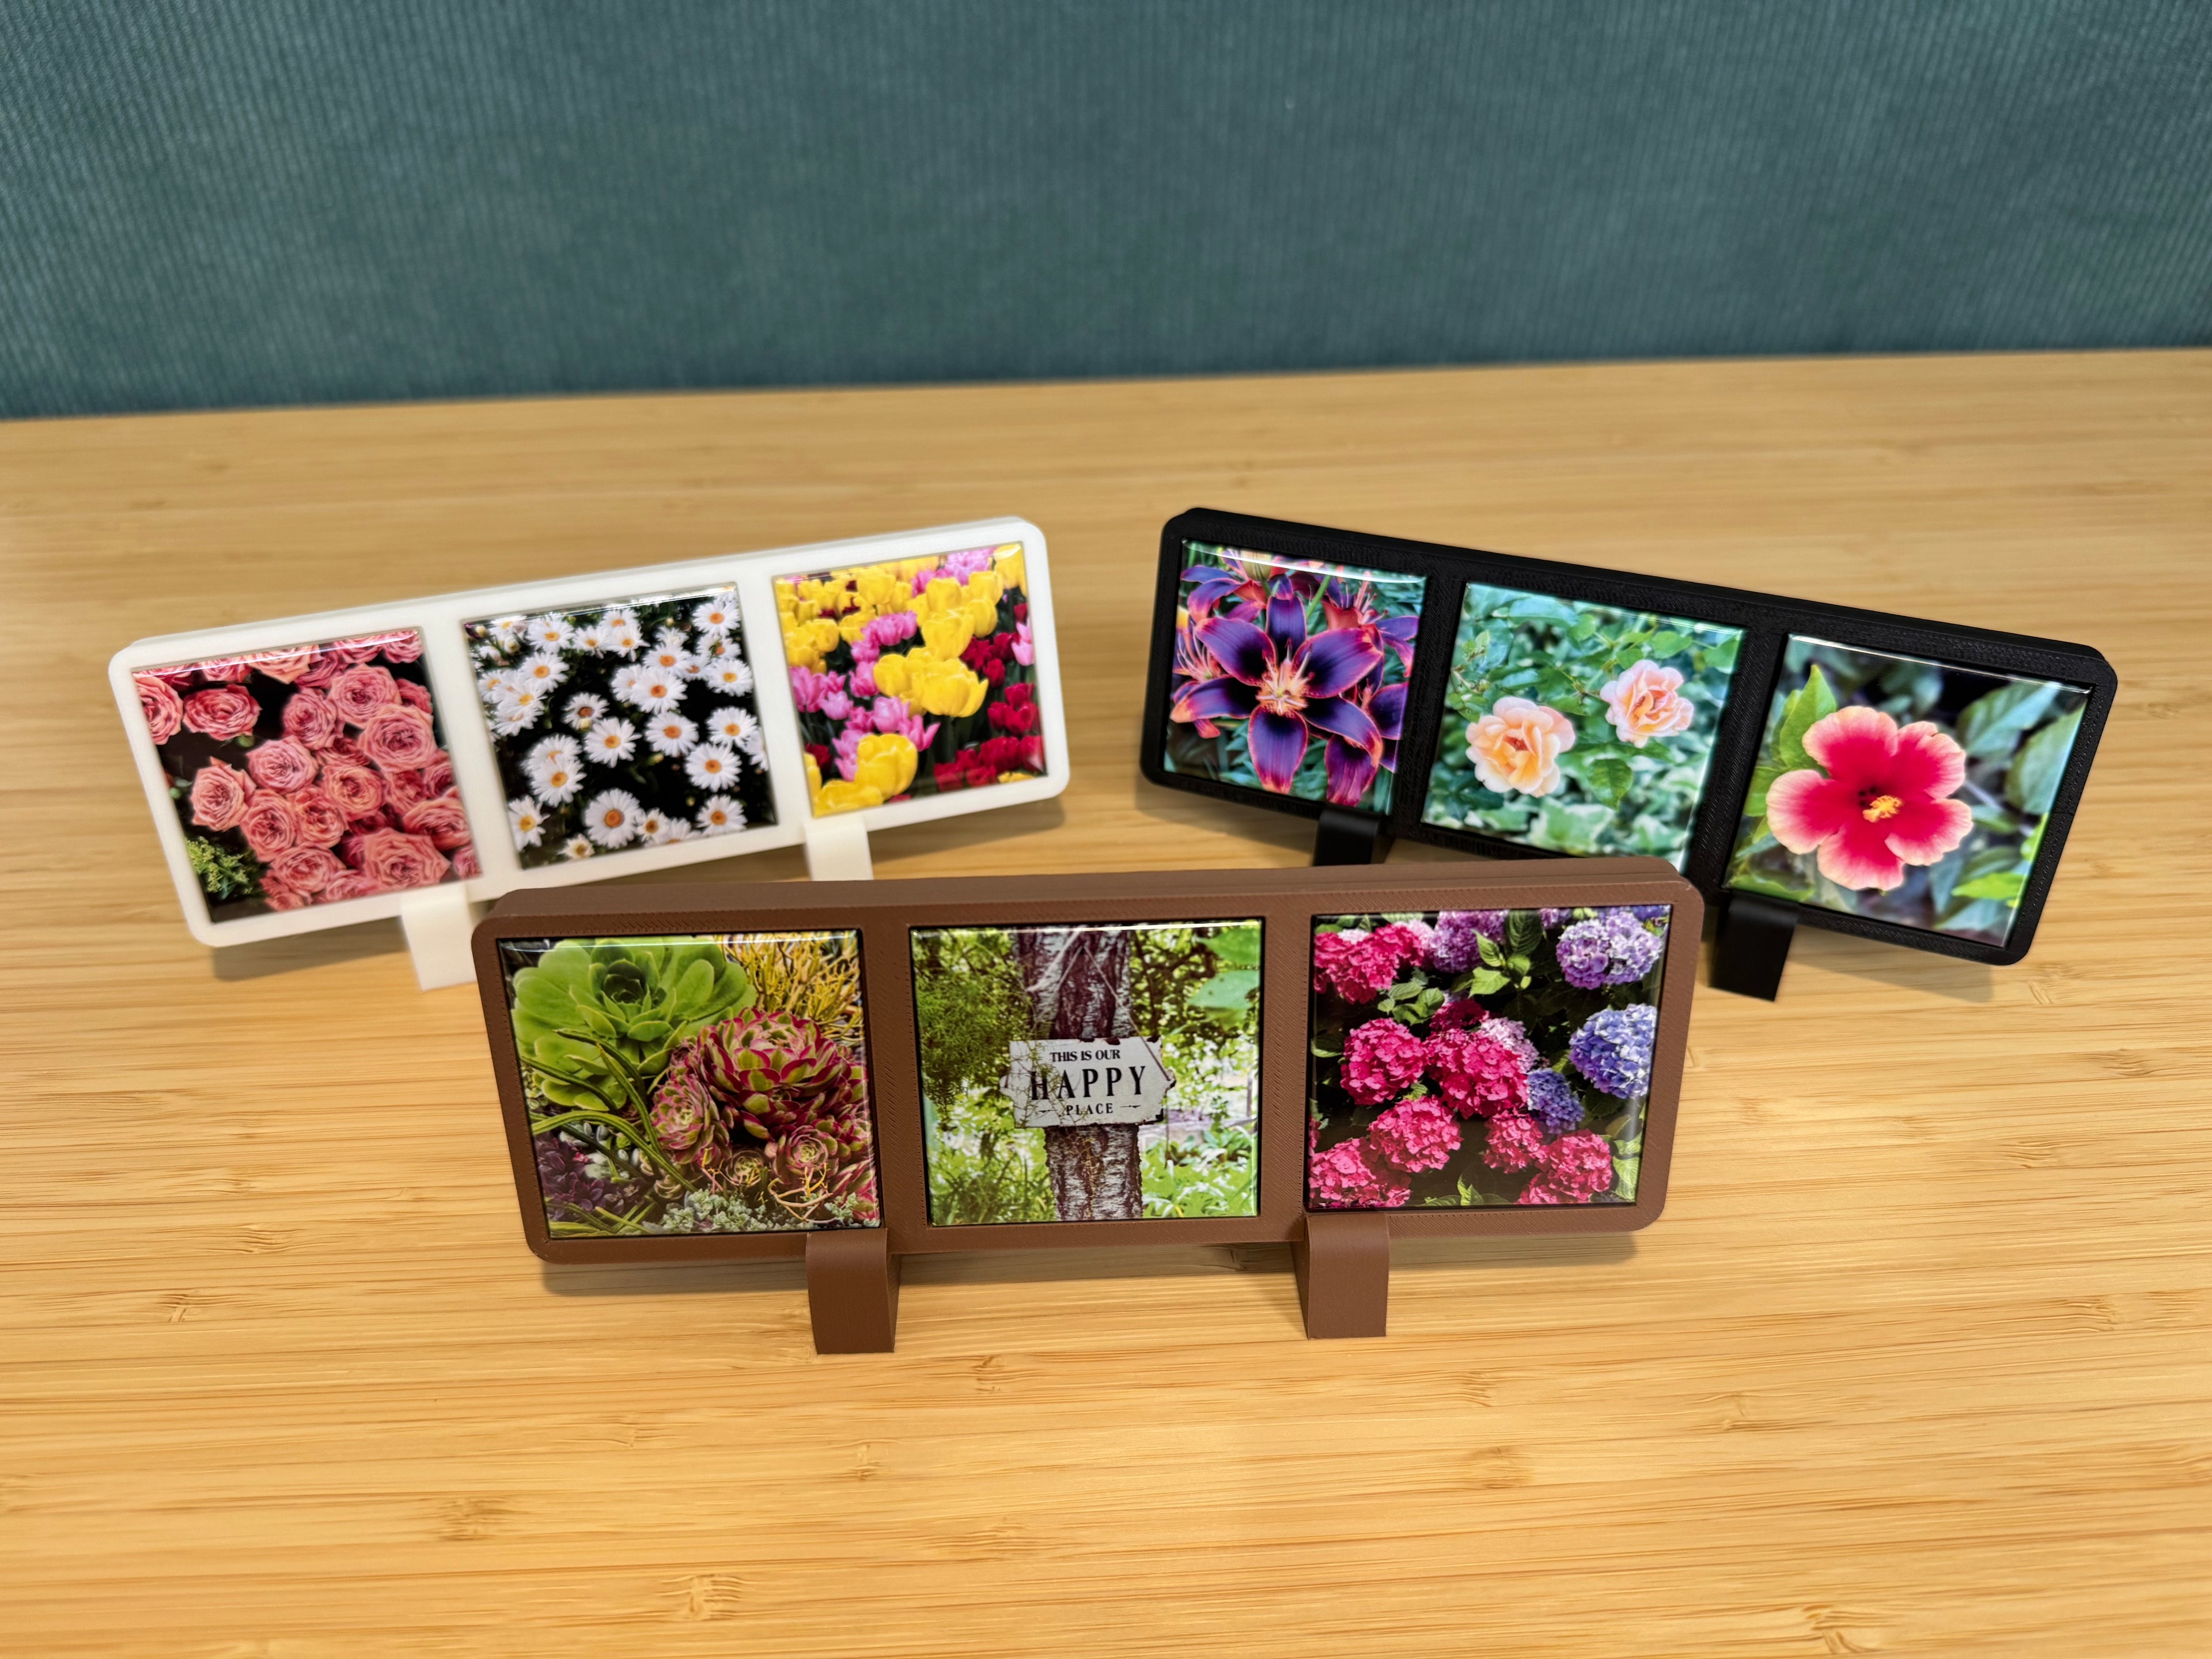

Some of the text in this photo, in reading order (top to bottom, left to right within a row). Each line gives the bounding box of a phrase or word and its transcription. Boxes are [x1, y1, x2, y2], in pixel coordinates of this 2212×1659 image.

[1050, 1049, 1120, 1062] THIS IS OUR
[1031, 1066, 1146, 1100] HAPPY
[1066, 1103, 1113, 1116] PLACE
